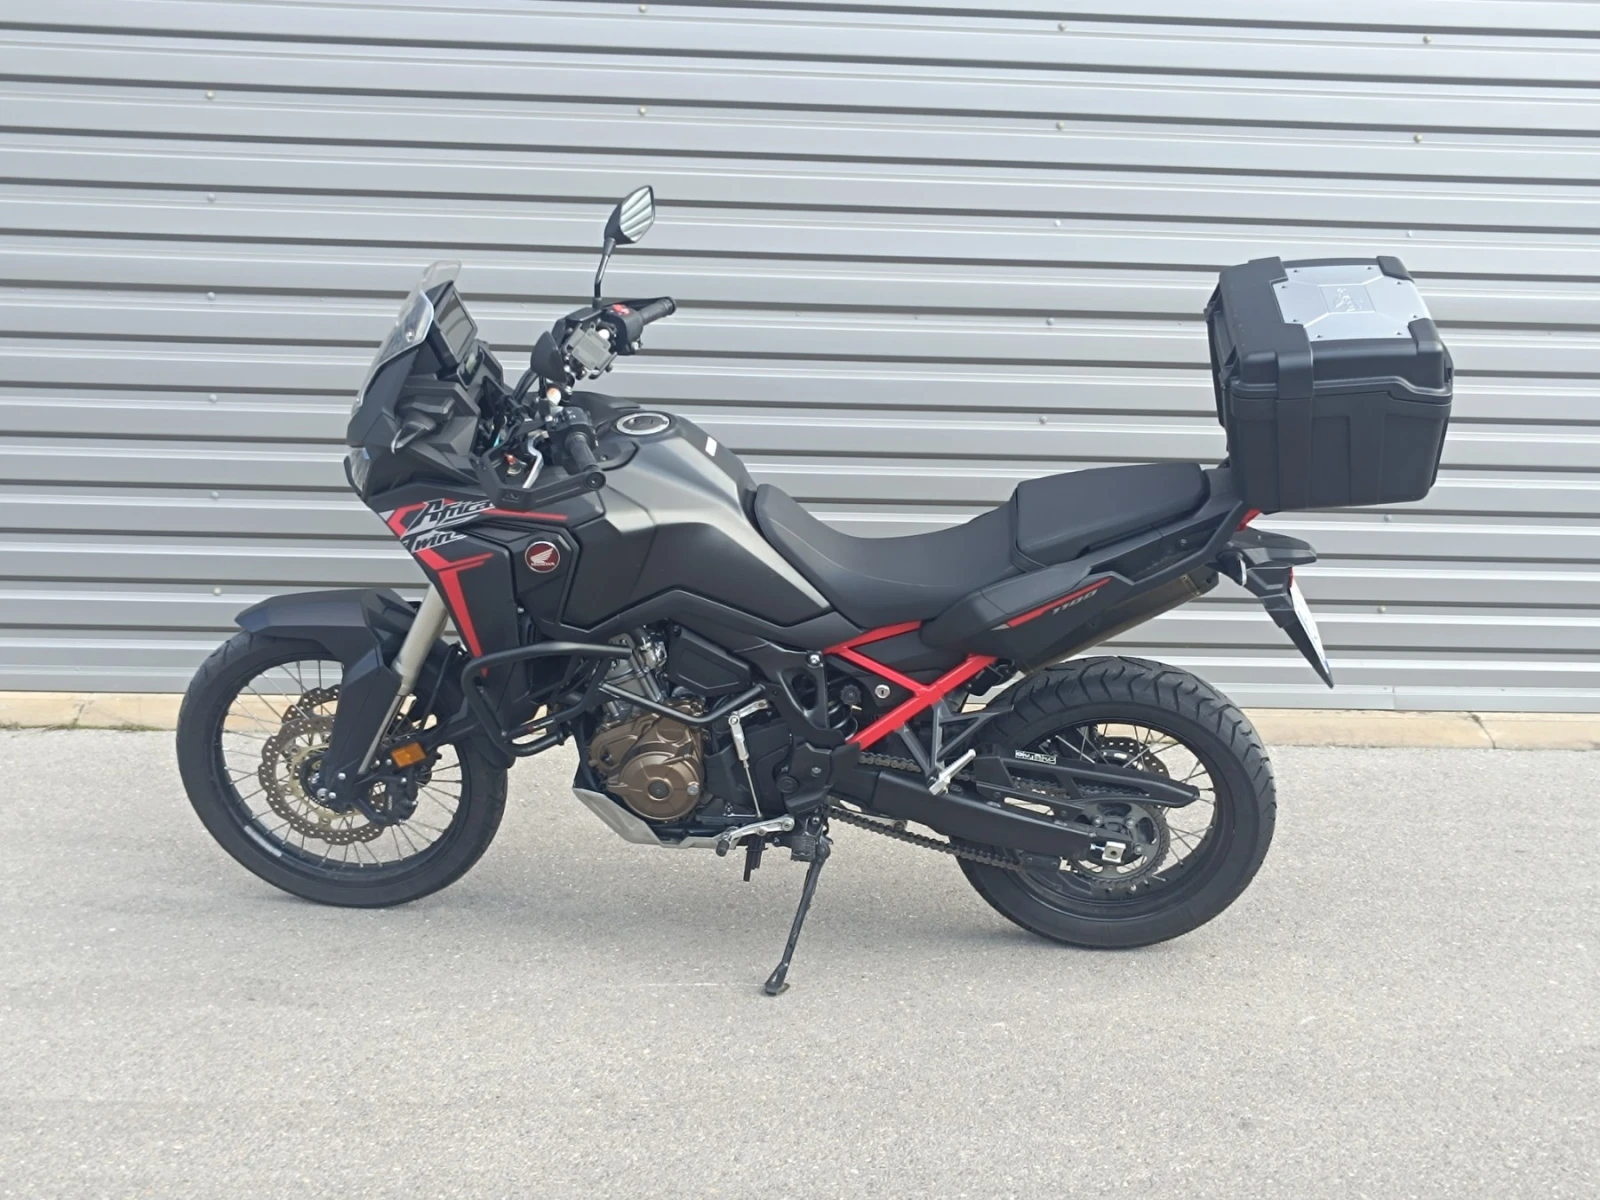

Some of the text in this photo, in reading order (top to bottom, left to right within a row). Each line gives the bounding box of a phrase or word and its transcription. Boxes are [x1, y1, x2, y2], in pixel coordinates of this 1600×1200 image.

[404, 498, 495, 533] Africa
[401, 530, 463, 552] Twin
[1052, 589, 1098, 615] 1100
